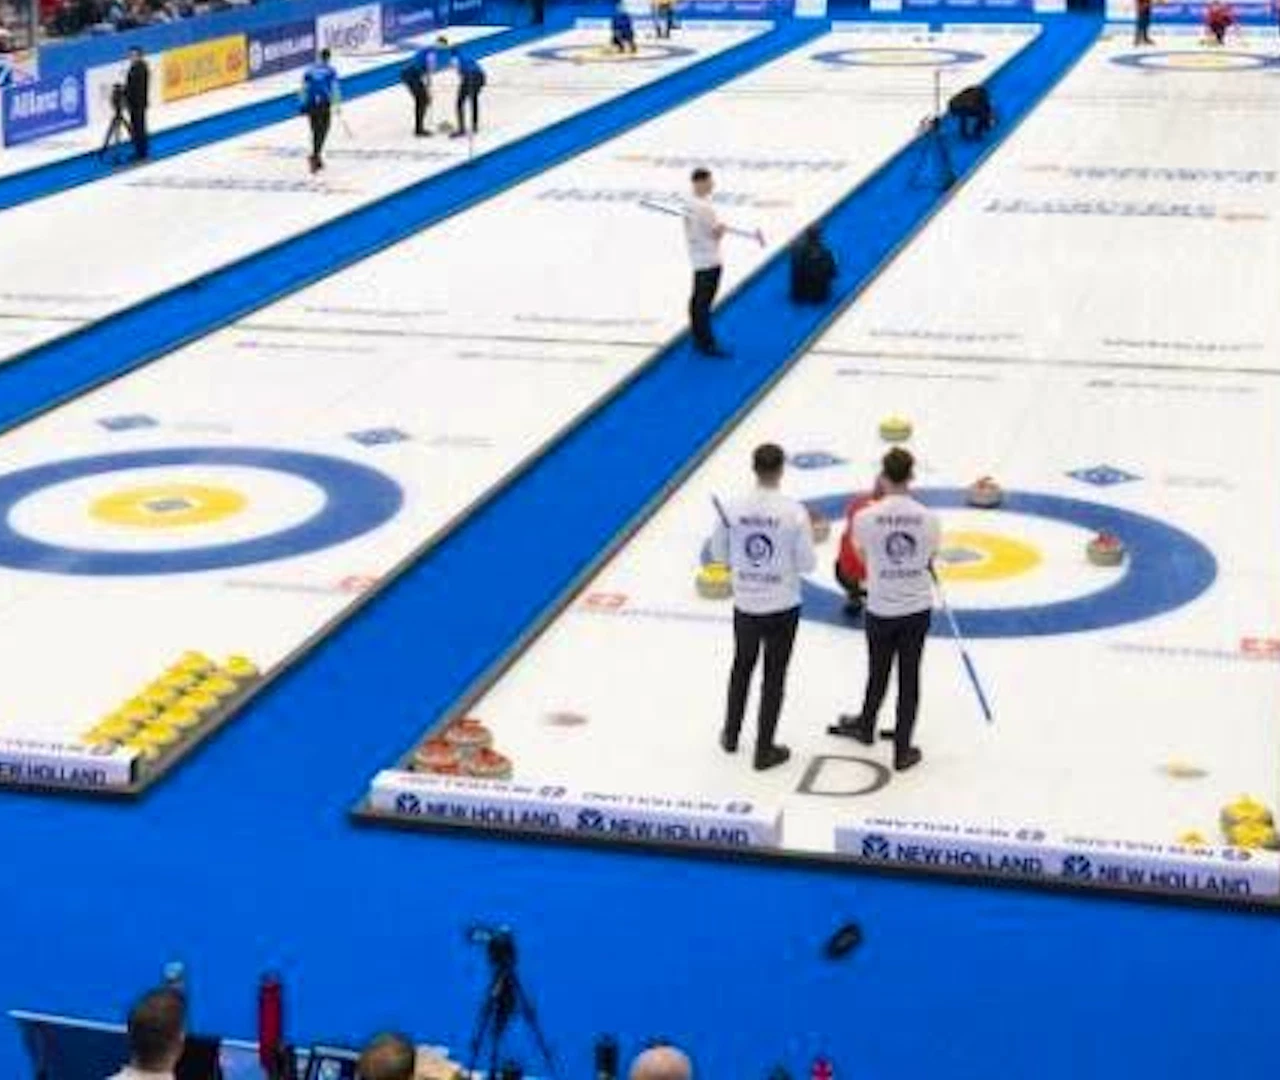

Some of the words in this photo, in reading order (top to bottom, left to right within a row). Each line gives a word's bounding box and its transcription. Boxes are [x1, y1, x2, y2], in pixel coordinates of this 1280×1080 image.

[795, 754, 891, 798] D
[426, 800, 468, 818] NEW
[472, 804, 561, 828] HOLLAND
[609, 818, 654, 841] NEW
[657, 823, 750, 847] HOLLAND
[897, 842, 942, 864] NEW
[945, 849, 1044, 874] HOLLAND
[1099, 864, 1146, 886] NEW
[1149, 870, 1252, 897] HOLLAND
